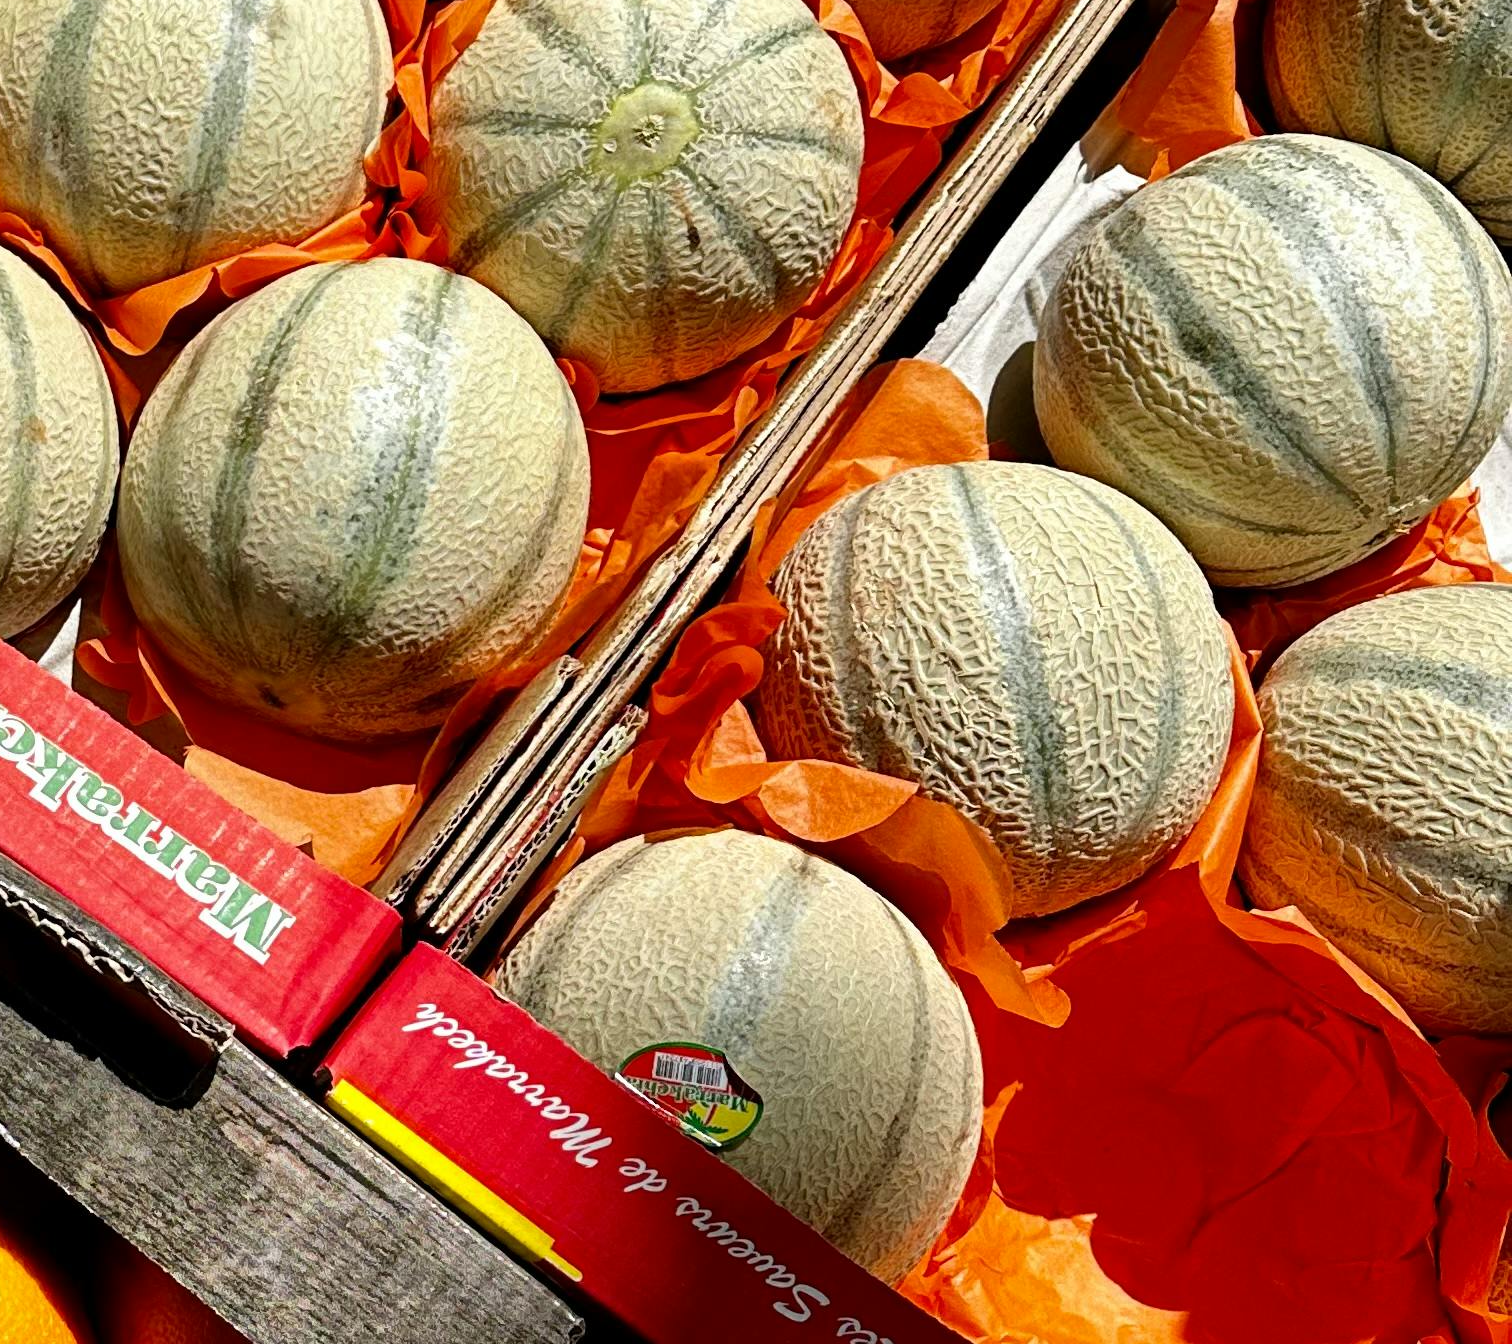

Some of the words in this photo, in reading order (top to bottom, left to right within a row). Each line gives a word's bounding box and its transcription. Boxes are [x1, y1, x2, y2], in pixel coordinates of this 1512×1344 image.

[401, 1003, 613, 1167] Marrakech
[625, 1076, 748, 1112] Marrakchia
[619, 1157, 666, 1193] de
[675, 1197, 830, 1323] Saveurs
